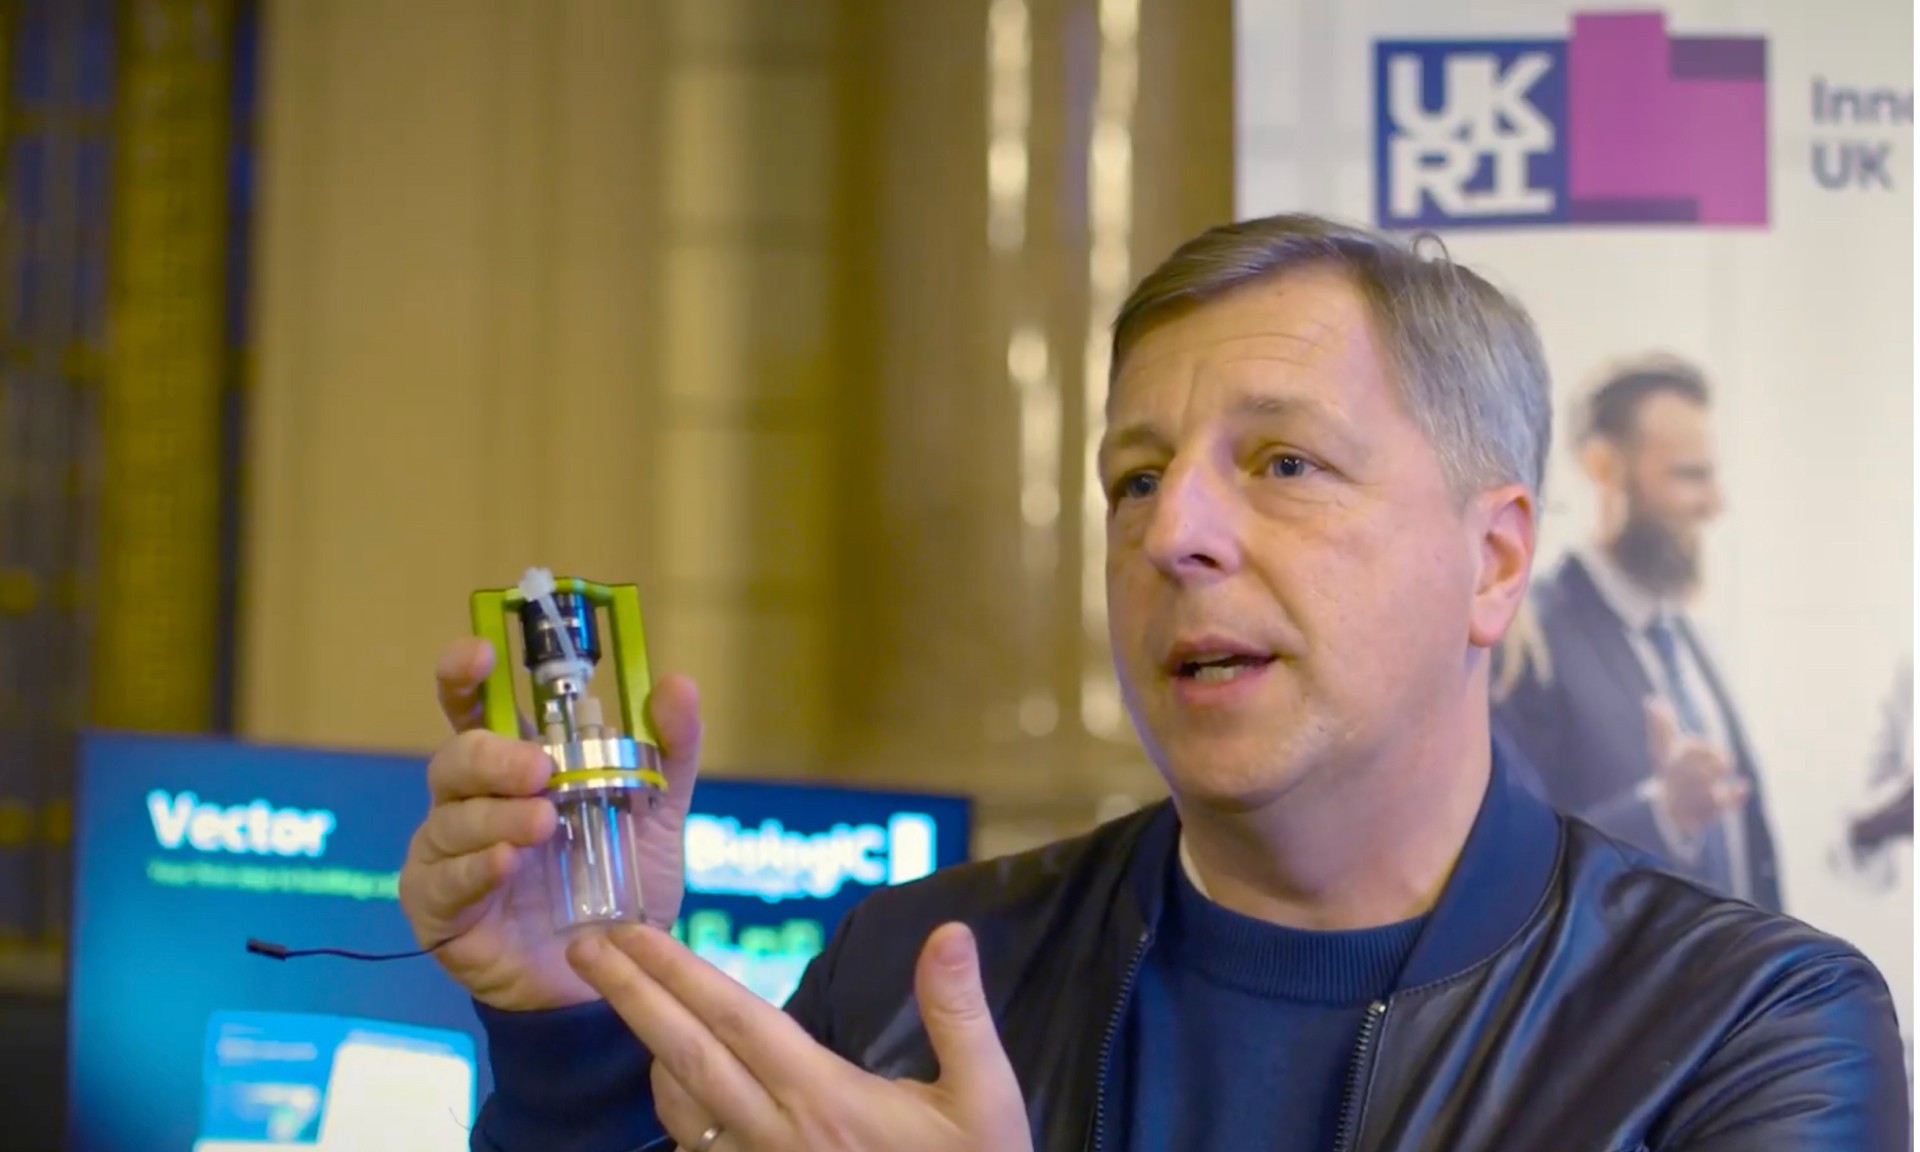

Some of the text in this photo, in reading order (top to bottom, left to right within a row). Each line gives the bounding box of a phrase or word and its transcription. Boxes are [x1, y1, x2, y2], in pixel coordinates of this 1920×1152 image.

[1811, 78, 1913, 125] Inn
[1811, 142, 1894, 190] UK
[146, 788, 336, 857] Vector
